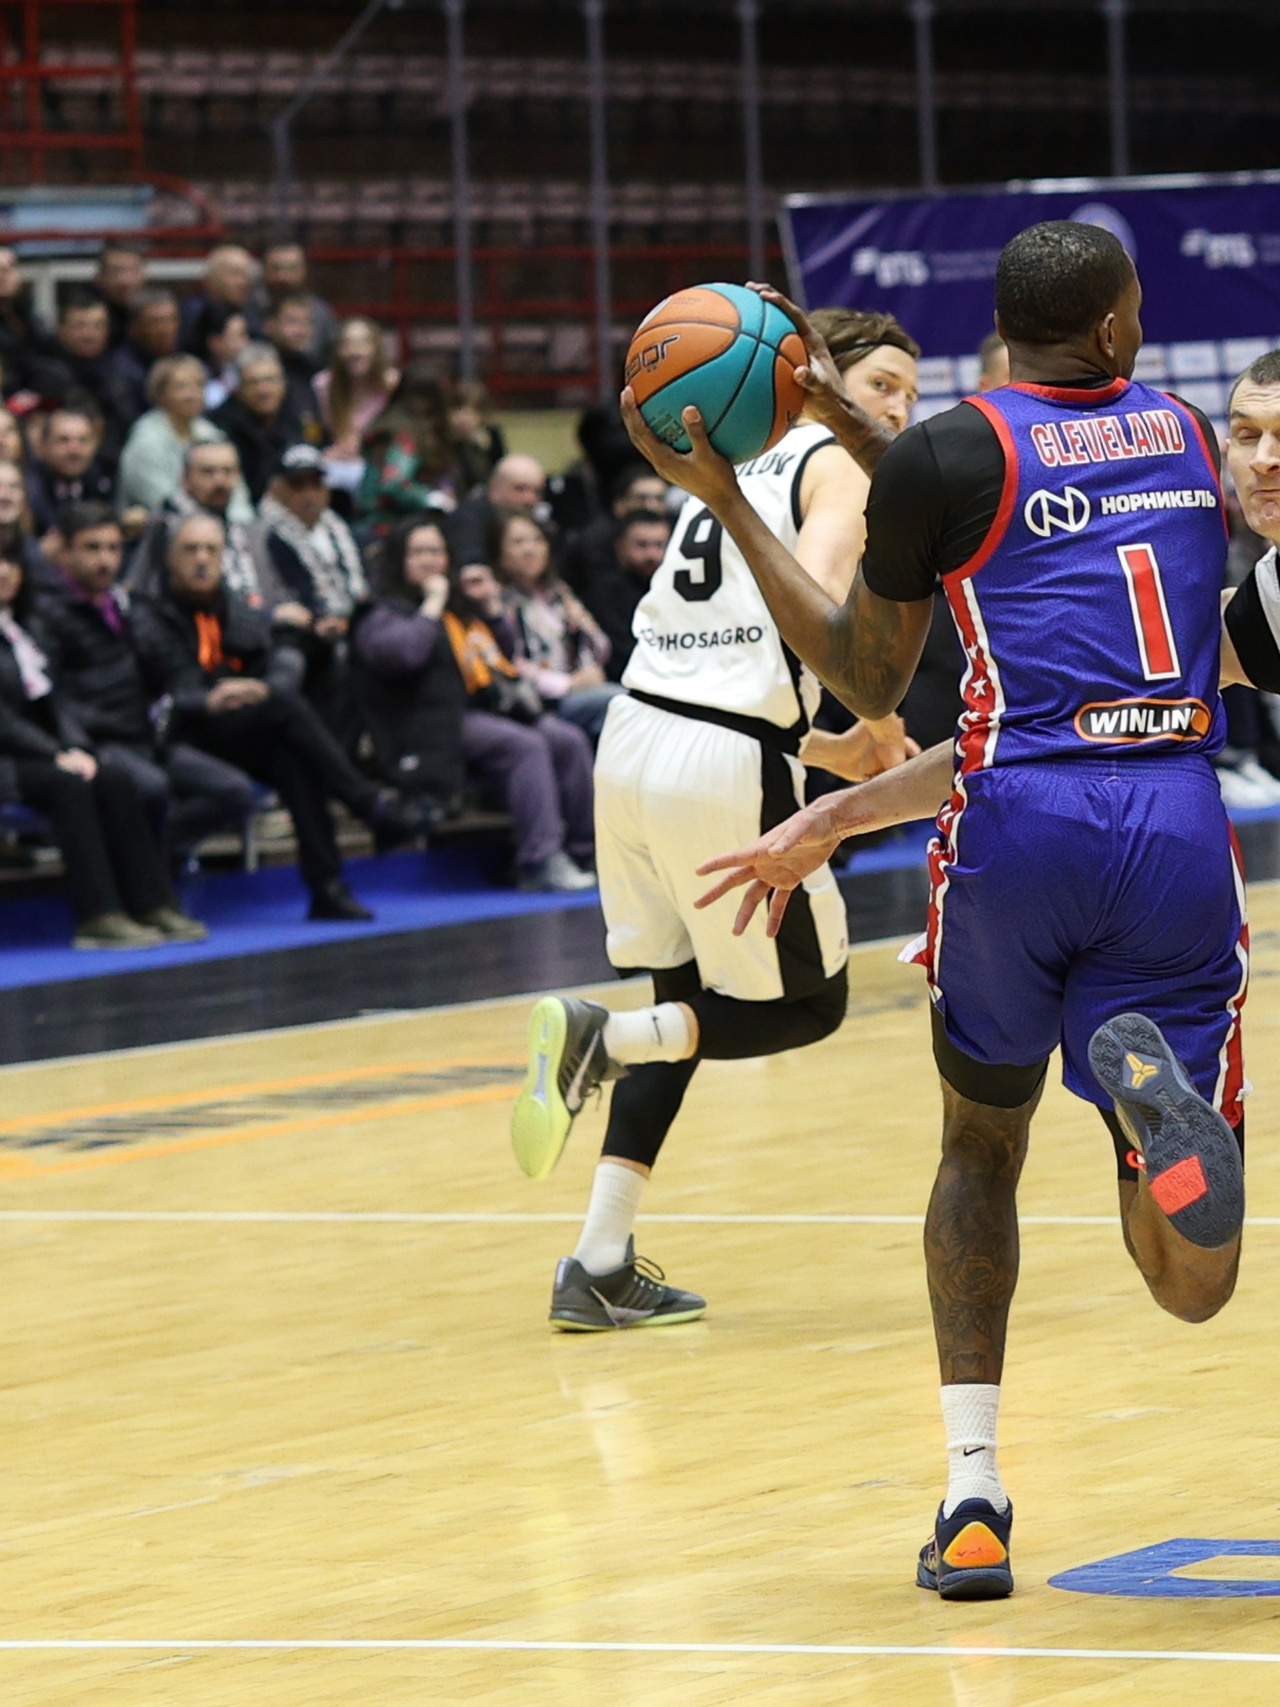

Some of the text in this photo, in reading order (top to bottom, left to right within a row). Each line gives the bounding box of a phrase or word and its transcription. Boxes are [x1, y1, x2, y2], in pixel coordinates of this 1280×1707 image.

[1030, 410, 1186, 467] CLEVELAND
[1101, 490, 1216, 515] НОРНИКЕЛЬ
[673, 505, 723, 602] 9
[1116, 543, 1181, 681] 1
[1089, 707, 1197, 734] WINLIN
